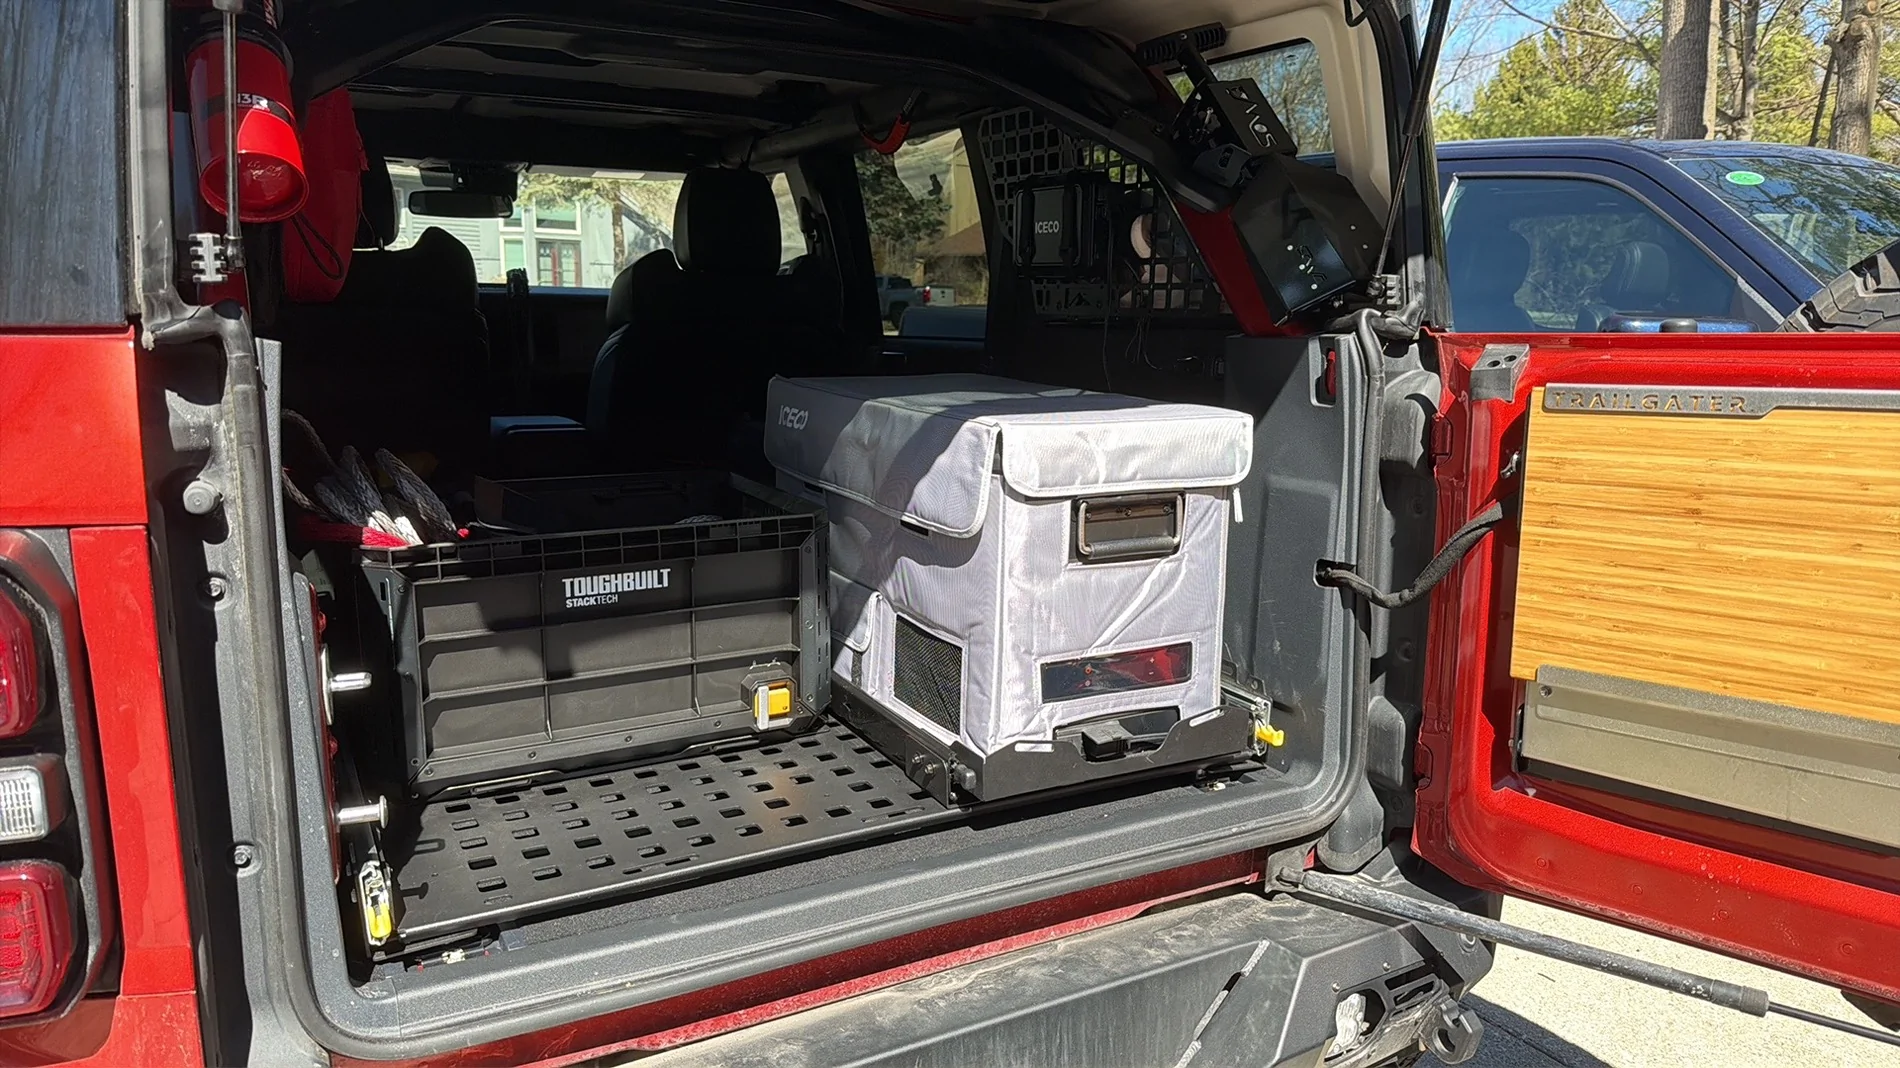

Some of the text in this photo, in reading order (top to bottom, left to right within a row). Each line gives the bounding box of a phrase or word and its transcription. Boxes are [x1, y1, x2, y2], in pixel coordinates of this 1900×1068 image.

[1034, 220, 1060, 234] ICECO
[1552, 391, 1747, 413] TRAILGATER
[778, 404, 809, 430] ICECO
[561, 568, 671, 598] TOUGHBUILT
[565, 594, 619, 608] STACKTECH
